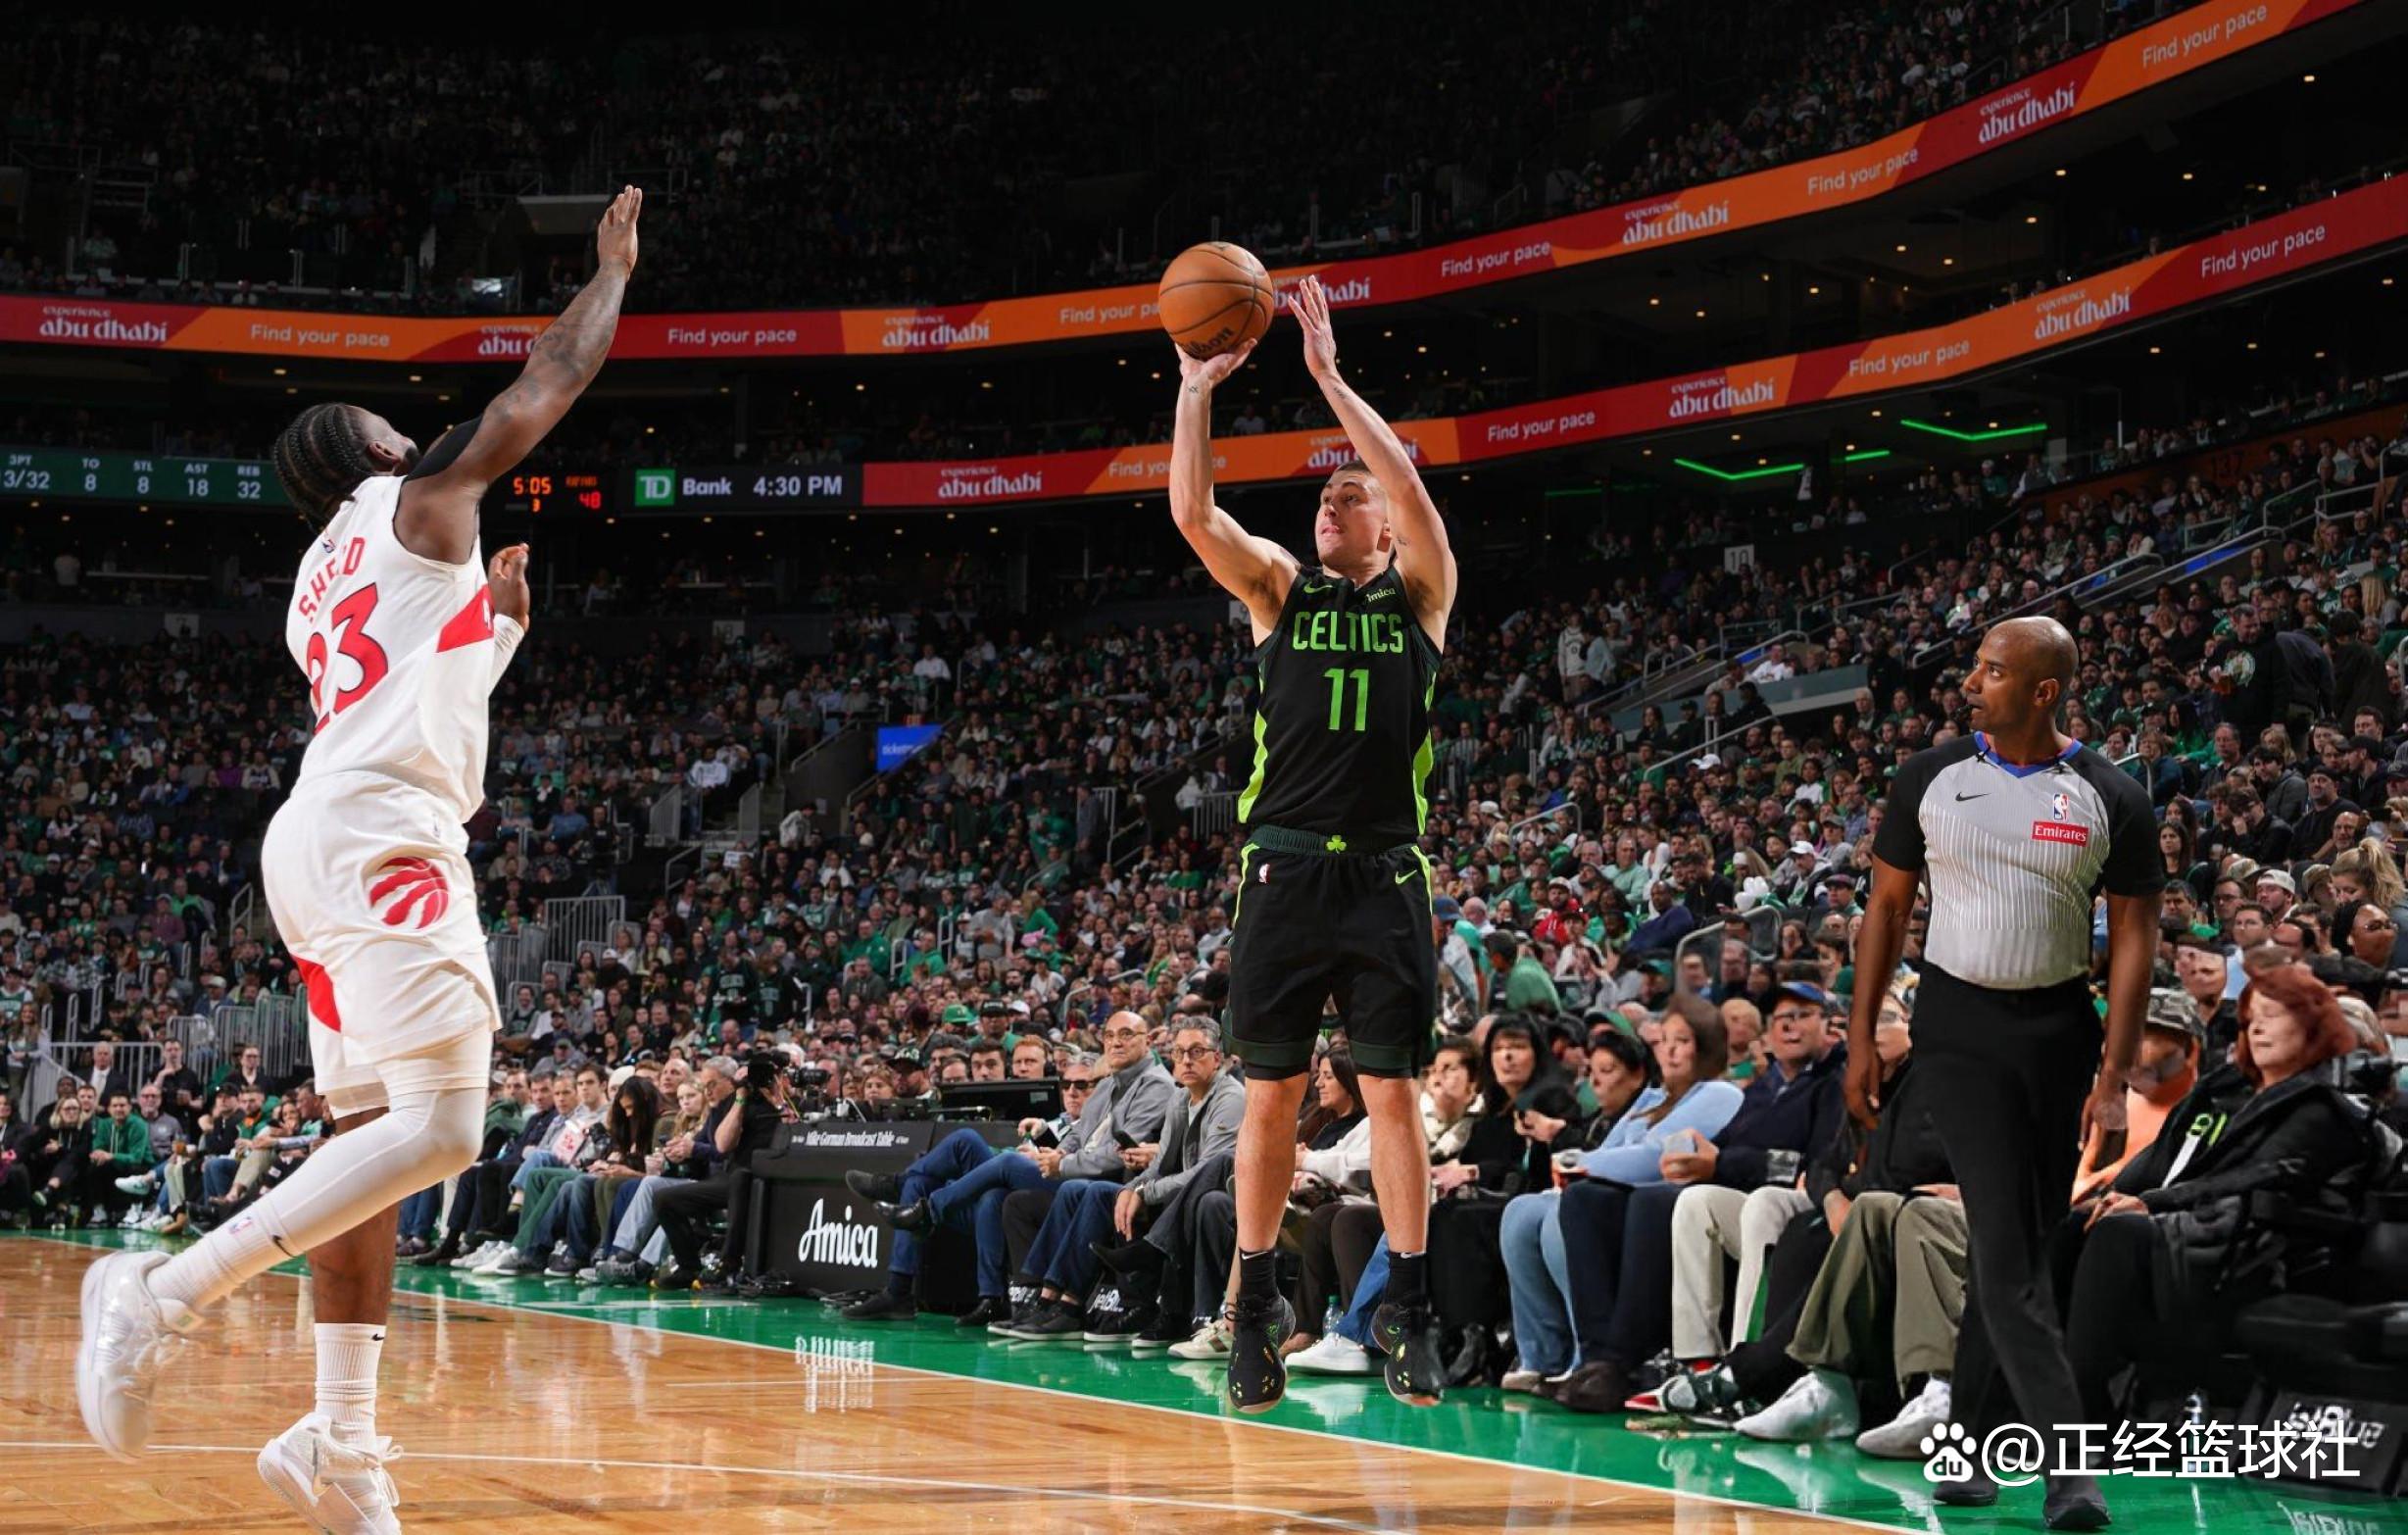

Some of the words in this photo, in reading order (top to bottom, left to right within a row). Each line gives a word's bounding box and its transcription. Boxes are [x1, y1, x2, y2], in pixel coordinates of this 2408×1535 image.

[2142, 38, 2178, 69] Find
[2182, 23, 2220, 57] your
[2225, 5, 2267, 39] pace
[1978, 114, 2015, 144] abu
[2018, 81, 2075, 127] dhabi
[1980, 87, 2031, 117] experience
[1807, 172, 1844, 196] Find
[1850, 162, 1882, 188] your
[1886, 148, 1918, 176] pace
[1623, 220, 1663, 245] abu
[1667, 200, 1729, 235] dhabi
[1442, 255, 1472, 277] Find
[1477, 249, 1509, 273] your
[1514, 242, 1549, 265] pace
[2201, 250, 2236, 278] Find
[2241, 238, 2279, 270] your
[2284, 225, 2325, 257] pace
[1059, 307, 1095, 323] Find
[1100, 304, 1135, 323] your
[2035, 314, 2071, 340] abu
[2074, 286, 2131, 327] dhabi
[40, 318, 89, 338] abu
[94, 321, 167, 342] dhabi
[250, 324, 292, 341] Find
[297, 329, 339, 347] your
[345, 332, 390, 347] pace
[667, 328, 706, 343] Find
[711, 331, 749, 347] your
[755, 328, 797, 346] pace
[883, 327, 926, 347] abu
[930, 321, 990, 346] dhabi
[478, 335, 521, 355] abu
[1848, 356, 1886, 376] Find
[1892, 350, 1930, 373] your
[1936, 340, 1970, 366] pace
[1671, 375, 1726, 394] experience
[1669, 394, 1709, 419] abu
[1713, 377, 1774, 411] dhabi
[1488, 423, 1518, 442] Find
[1522, 419, 1555, 440] your
[1559, 411, 1596, 433] pace
[9, 454, 32, 467] 3PT
[82, 458, 100, 470] TO
[133, 461, 153, 472] STL
[184, 464, 209, 474] AST
[1108, 461, 1143, 477] Find
[1307, 447, 1351, 469] abu
[3, 470, 50, 489] 3/32
[237, 465, 261, 476] REB
[84, 474, 96, 491] 8
[137, 476, 149, 494] 8
[187, 477, 209, 496] 18
[237, 481, 261, 499] 32
[639, 475, 671, 499] TD
[682, 476, 732, 496] Bank
[753, 475, 801, 497] 4:30
[808, 475, 843, 496] PM
[938, 478, 979, 498] abu
[983, 471, 1042, 496] dhabi
[579, 491, 602, 510] 48
[1292, 611, 1403, 654] CELTICS
[306, 582, 389, 735] 23
[1324, 668, 1370, 731] 11
[2035, 824, 2088, 843] Emirates
[798, 1198, 878, 1268] Amica
